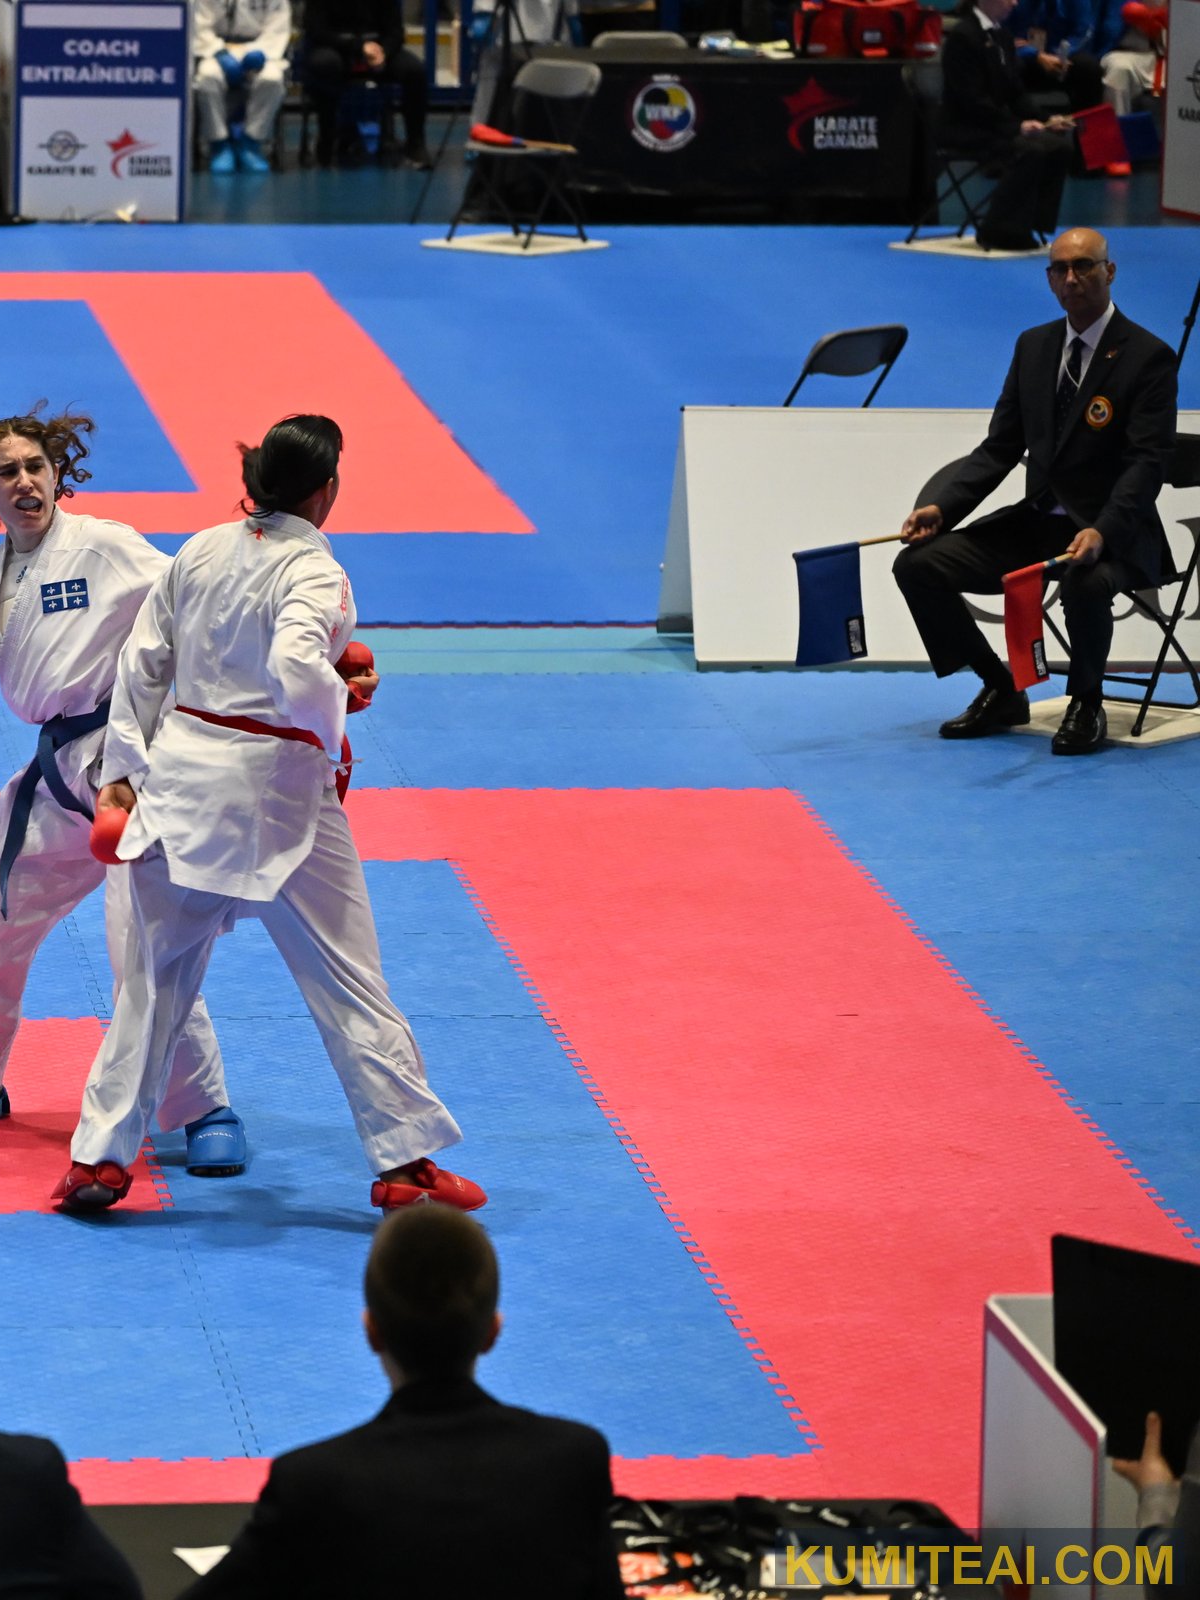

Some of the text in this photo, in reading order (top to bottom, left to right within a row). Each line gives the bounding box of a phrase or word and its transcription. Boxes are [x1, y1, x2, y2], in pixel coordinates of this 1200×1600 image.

[63, 39, 140, 56] COACH
[814, 116, 878, 133] KARATE
[813, 133, 879, 149] CANADA
